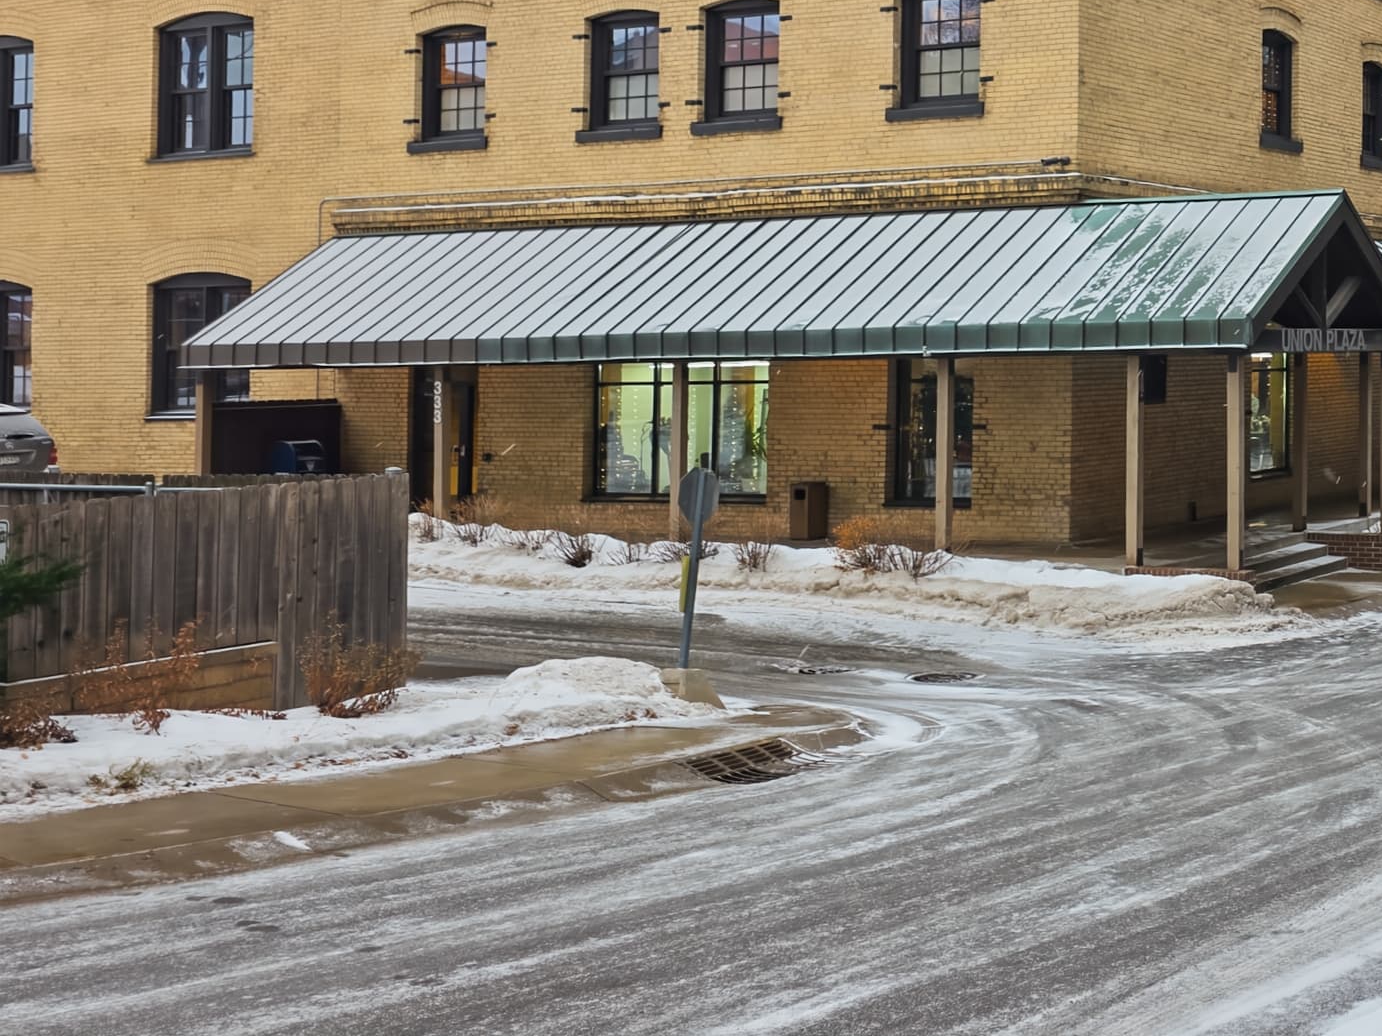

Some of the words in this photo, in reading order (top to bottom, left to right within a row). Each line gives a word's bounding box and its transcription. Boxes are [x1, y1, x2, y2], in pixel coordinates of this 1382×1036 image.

[1281, 329, 1322, 352] UNION
[1326, 329, 1367, 350] PLAZA
[433, 380, 442, 424] 333
